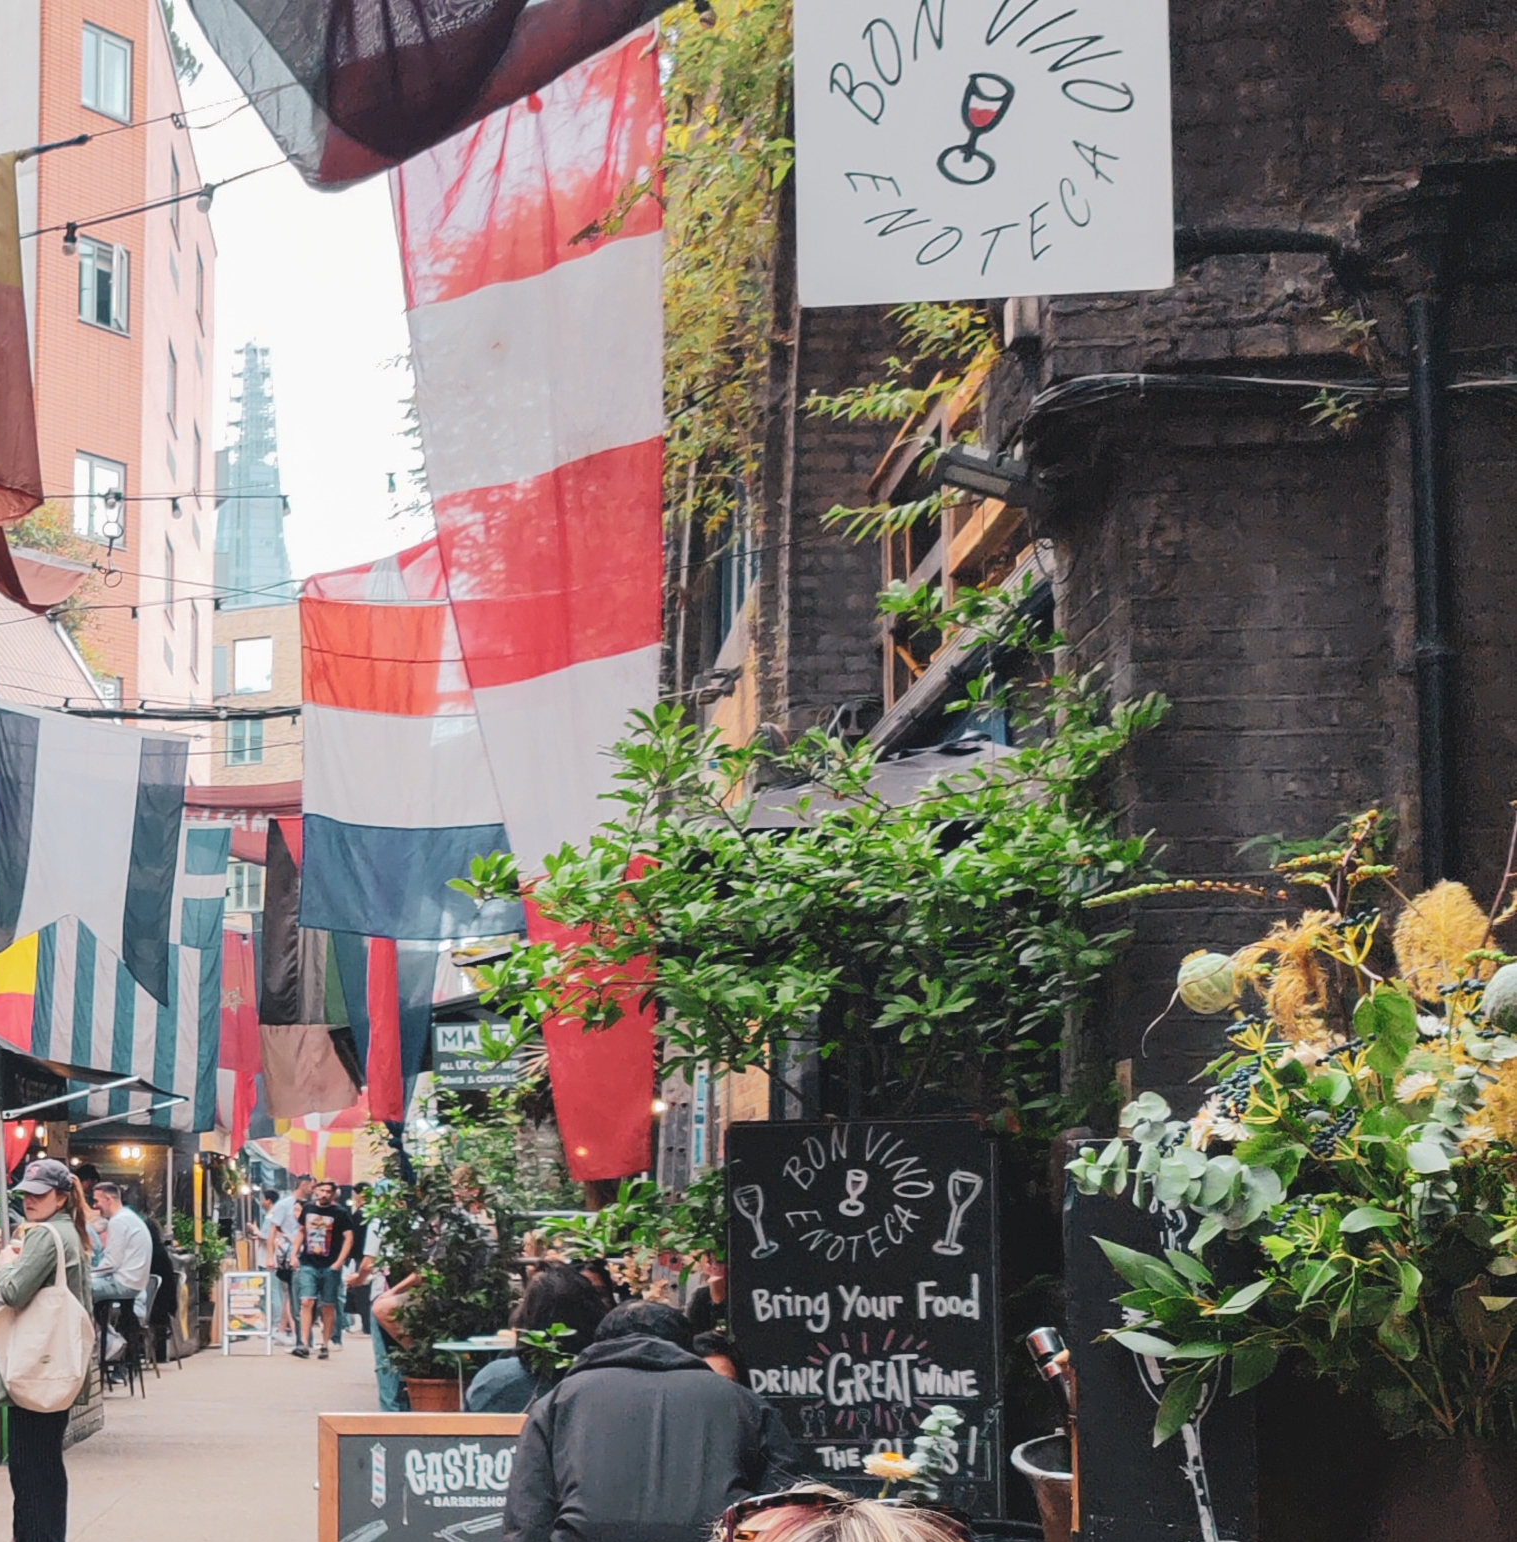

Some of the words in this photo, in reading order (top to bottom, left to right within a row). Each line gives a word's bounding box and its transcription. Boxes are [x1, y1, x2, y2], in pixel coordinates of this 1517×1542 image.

[830, 0, 947, 126] BON
[985, 0, 1135, 113] VINO
[844, 139, 1120, 277] ENOTECA
[783, 1124, 850, 1191] BON
[865, 1125, 935, 1199] VINO
[784, 1203, 922, 1263] ENOTECA
[750, 1286, 831, 1334] Bring
[838, 1284, 904, 1323] Your
[916, 1272, 981, 1321] Food
[826, 1351, 920, 1408] GREAT
[815, 1445, 862, 1470] THE
